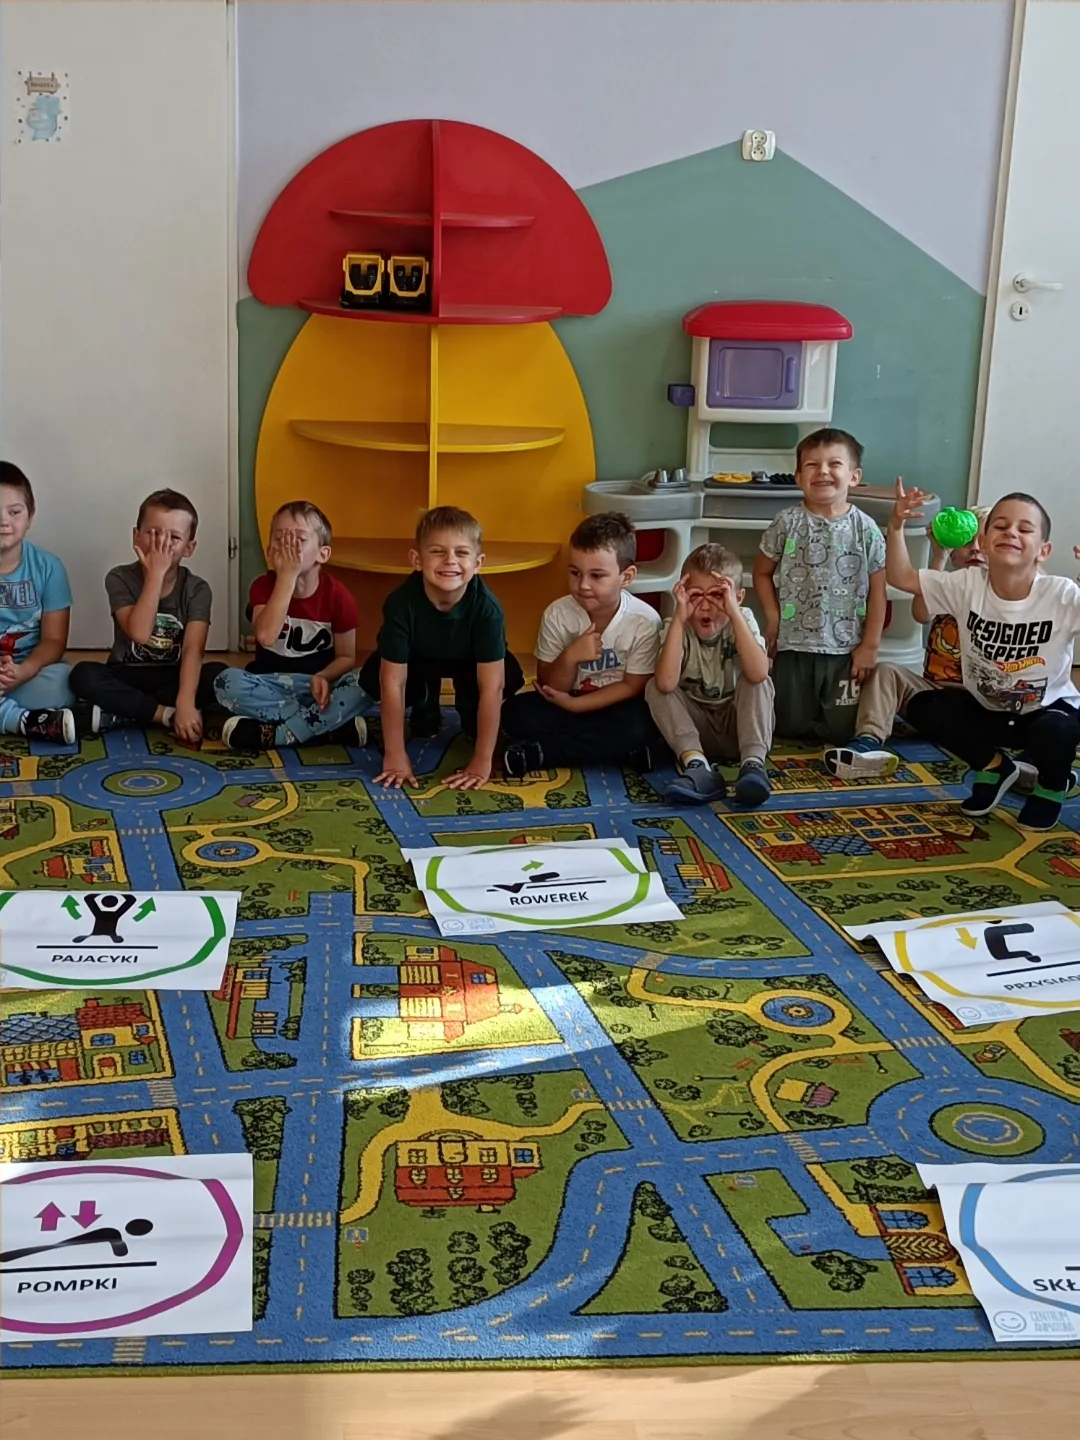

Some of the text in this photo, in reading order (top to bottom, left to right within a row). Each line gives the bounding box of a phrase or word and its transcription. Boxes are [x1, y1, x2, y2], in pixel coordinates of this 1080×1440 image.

[966, 610, 1053, 645] DESIGNED
[983, 643, 1040, 662] SPEED
[838, 679, 861, 699] 76
[509, 890, 590, 906] ROWEREK
[51, 954, 139, 964] PAJACYKI
[16, 1276, 118, 1294] POMPKI
